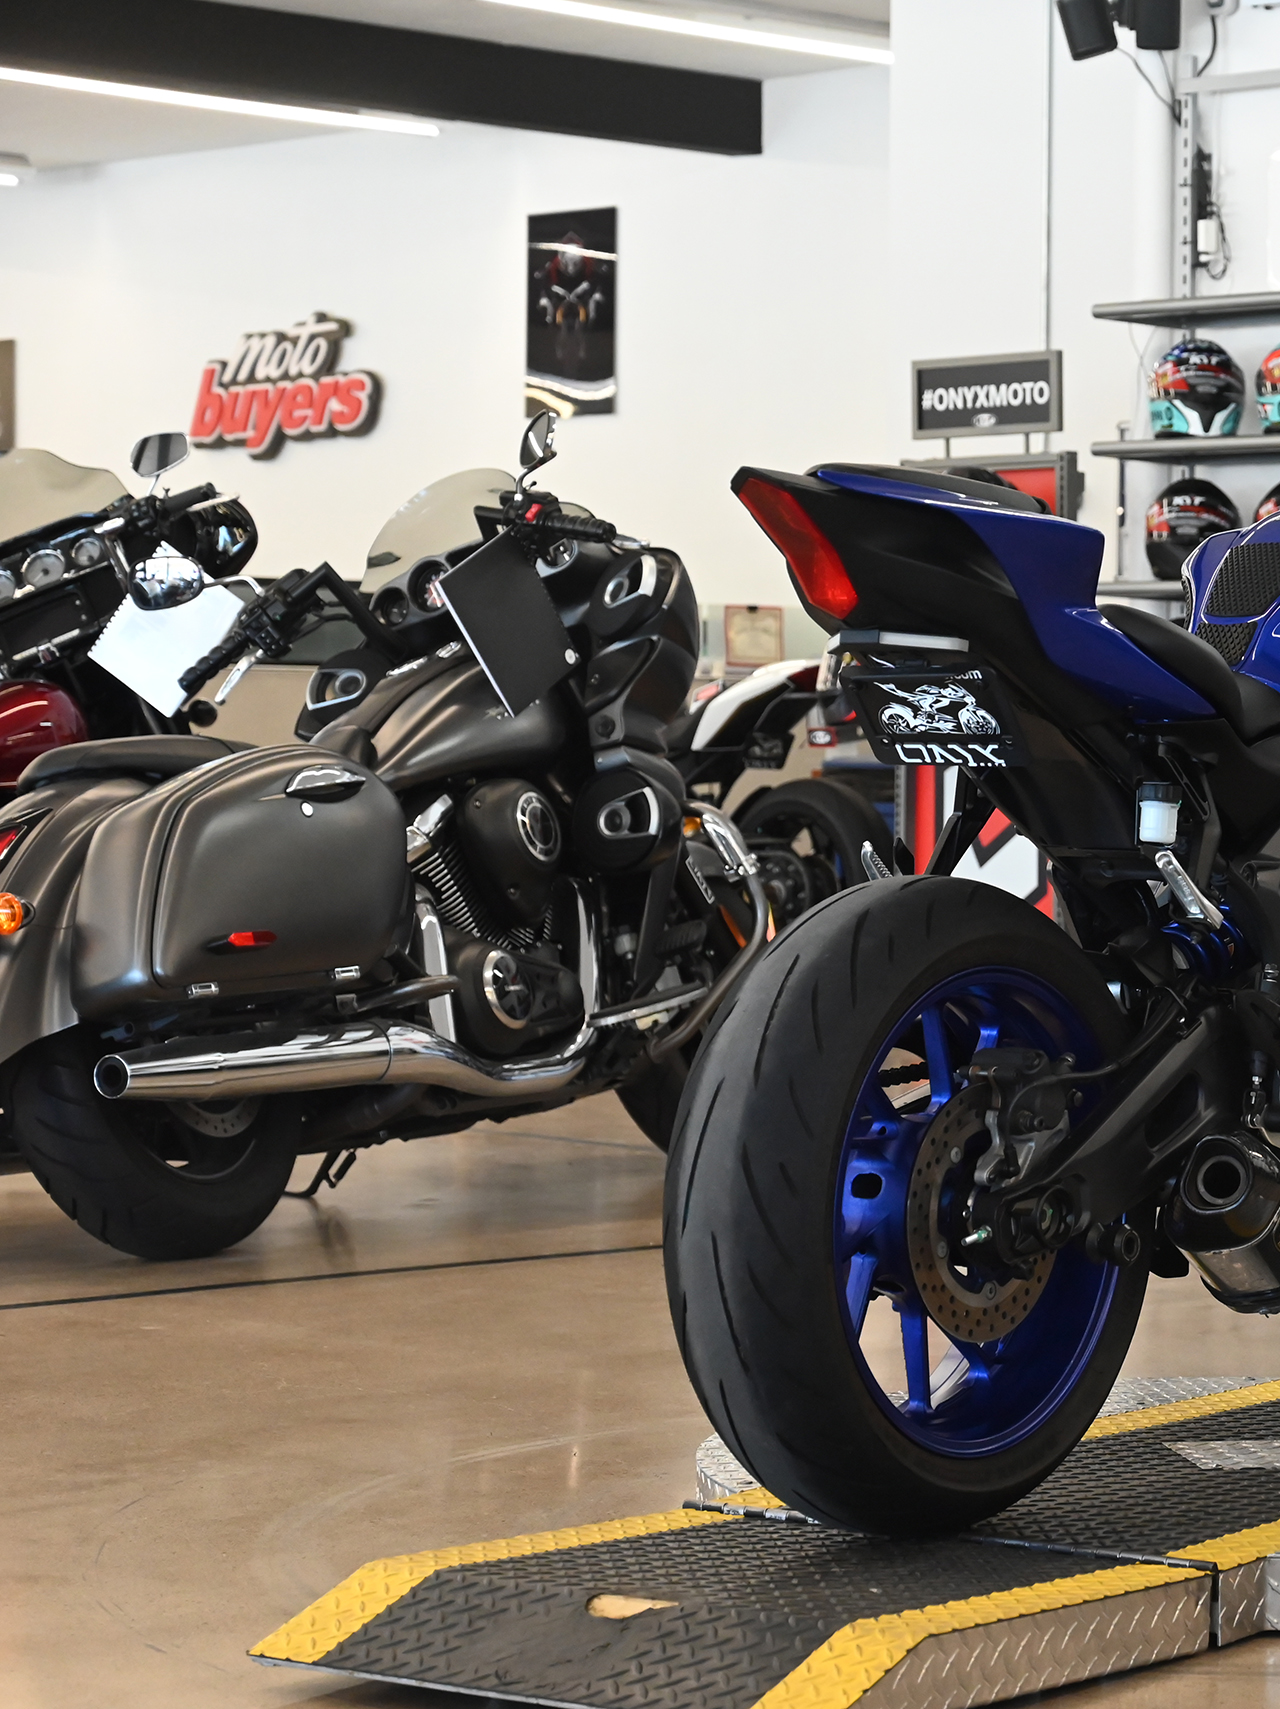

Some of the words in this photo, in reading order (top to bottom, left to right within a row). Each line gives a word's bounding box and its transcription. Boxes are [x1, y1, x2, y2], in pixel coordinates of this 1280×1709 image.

[188, 364, 371, 452] buyers
[921, 380, 1051, 412] #ONYXMOTO
[895, 743, 1006, 767] ONYX
